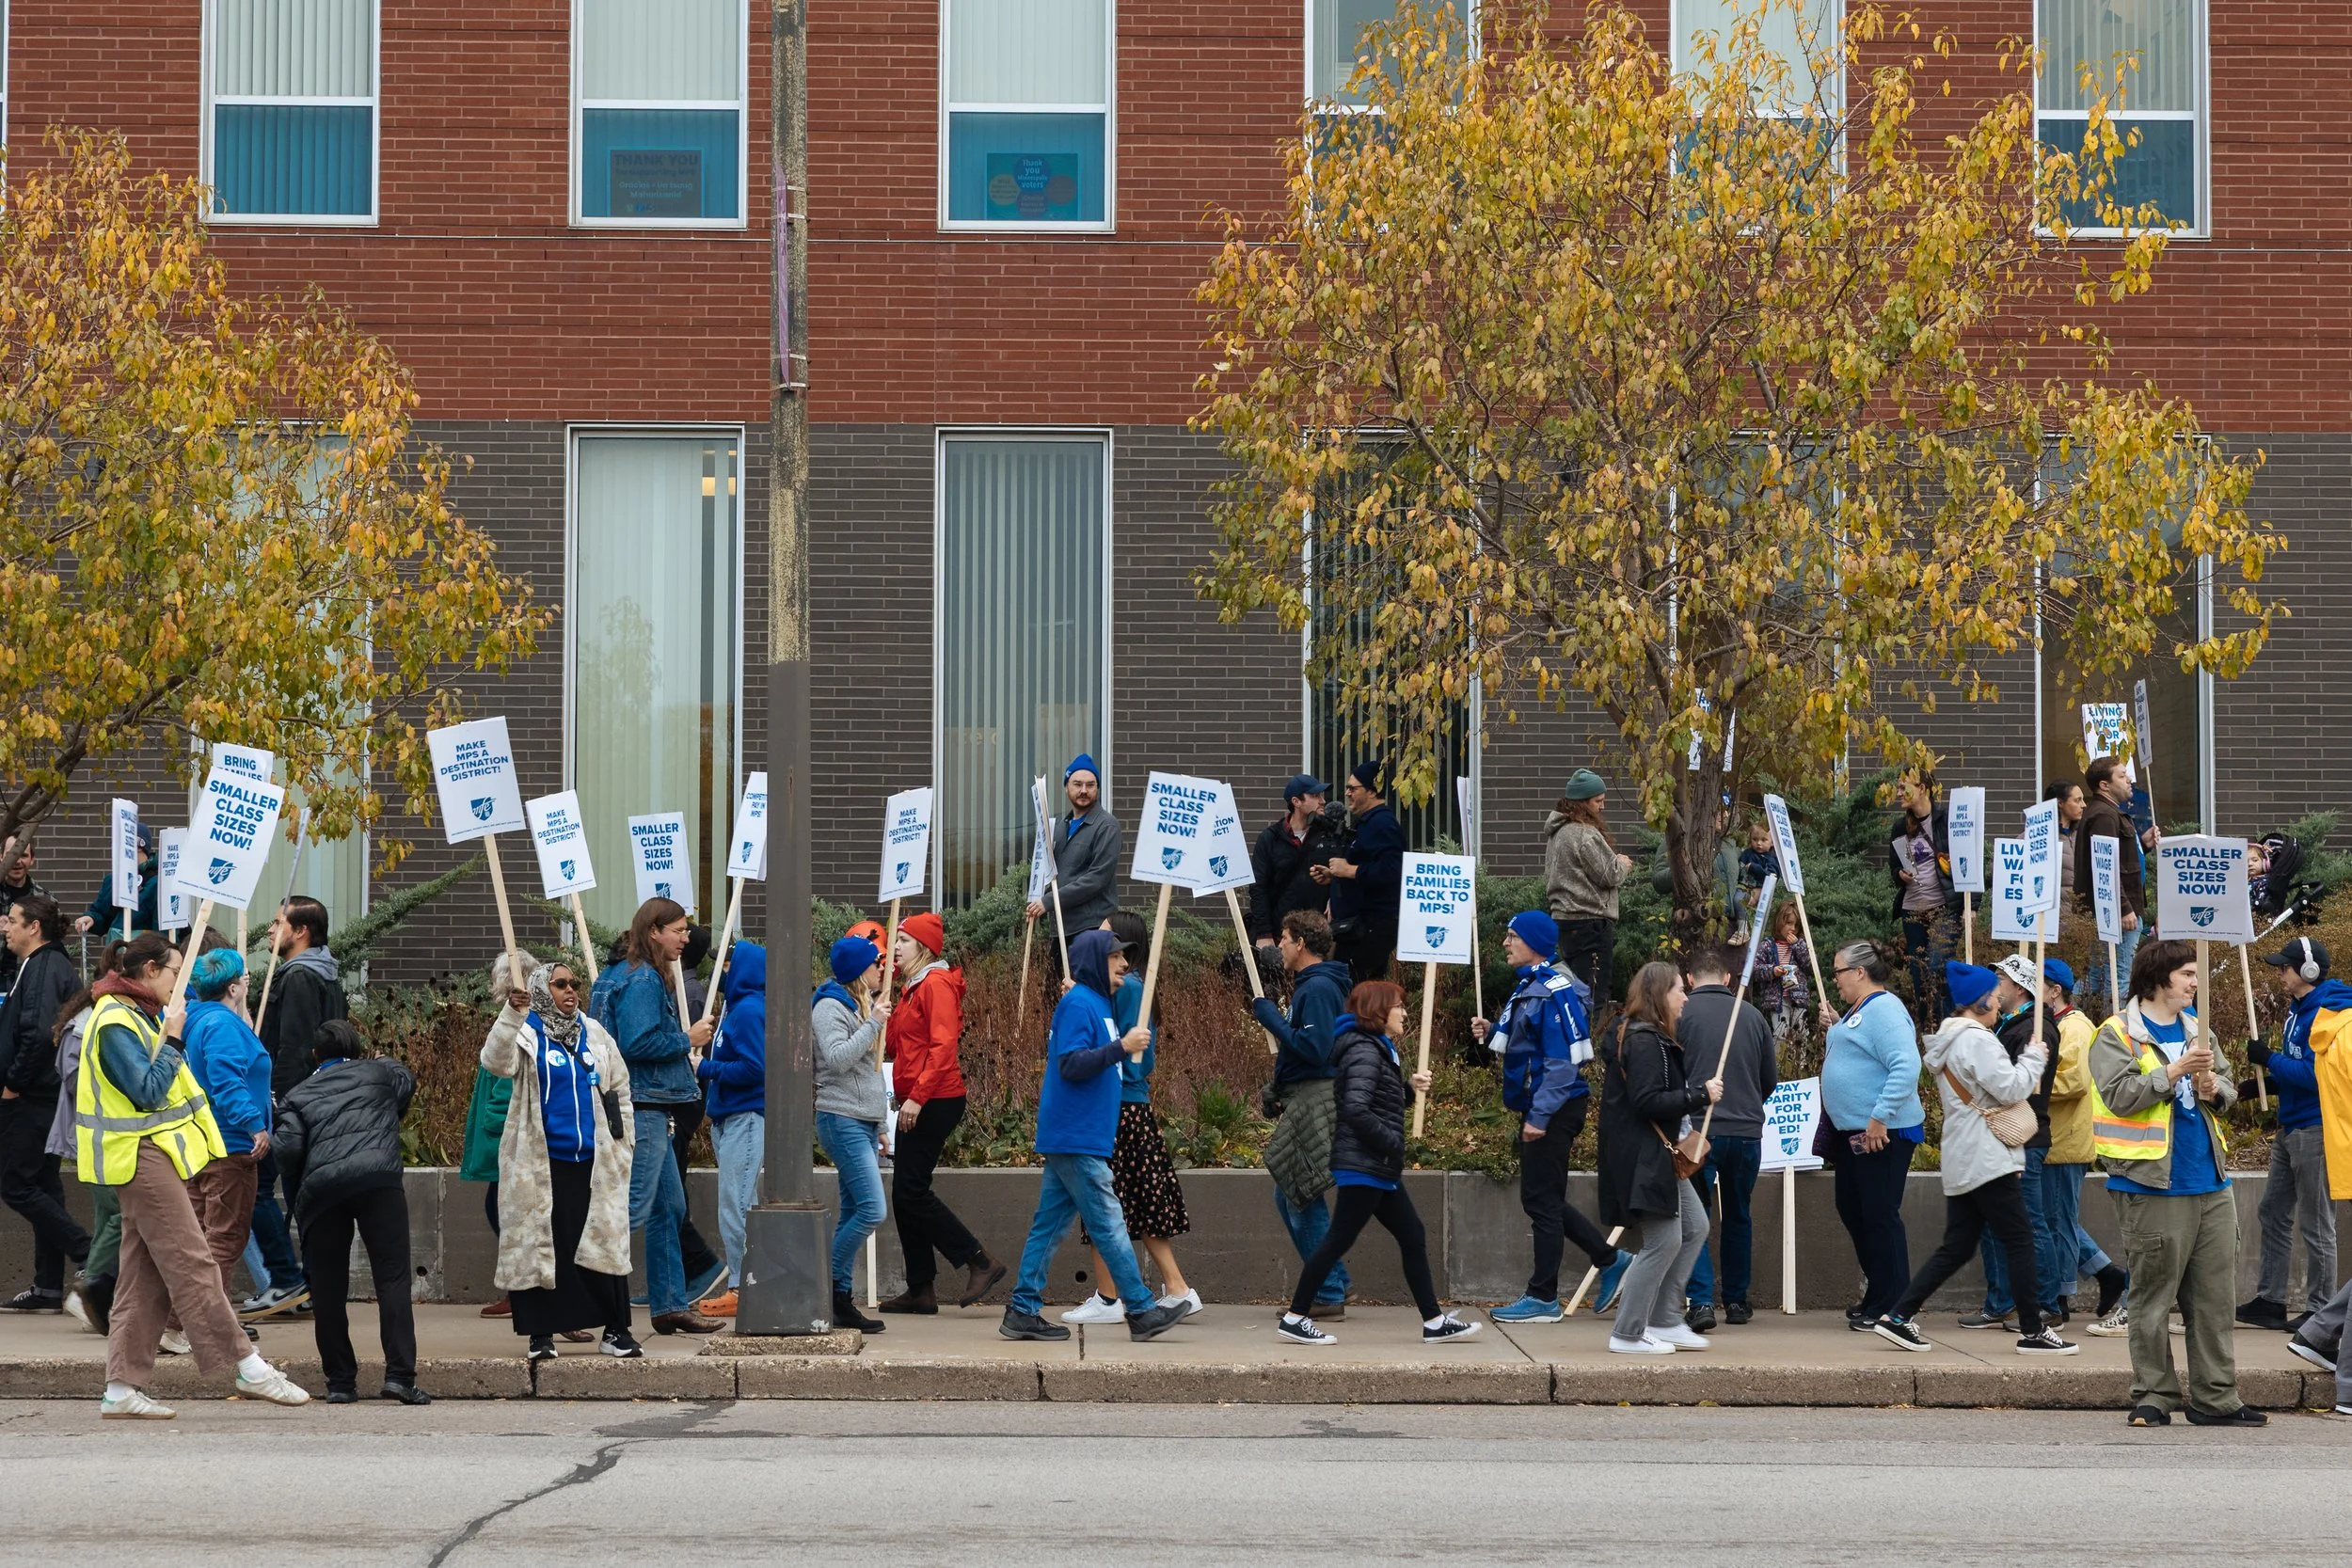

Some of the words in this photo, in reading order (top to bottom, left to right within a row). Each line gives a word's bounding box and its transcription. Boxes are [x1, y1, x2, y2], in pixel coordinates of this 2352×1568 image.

[614, 154, 663, 166] THANK
[668, 154, 698, 166] YOU
[1025, 167, 1041, 176] you
[455, 739, 486, 752] MAKE
[224, 754, 257, 770] BRING
[455, 752, 479, 762] MPS
[440, 755, 509, 775] DESTINATION
[451, 766, 501, 783] DISTRICT!
[209, 780, 278, 812] SMALLER
[1151, 783, 1216, 803] SMALLER
[215, 798, 264, 822] CLASS
[1158, 797, 1204, 814] CLASS
[546, 809, 565, 819] MAKE
[899, 808, 917, 817] MAKE
[1159, 810, 1199, 826] SIZES
[214, 814, 257, 836] SIZES
[547, 818, 563, 828] MPS
[898, 817, 911, 827] MPS
[1214, 816, 1234, 828] TION
[1949, 821, 1974, 830] DESTINATION
[2026, 810, 2053, 829] SMALLER
[537, 822, 580, 839] DESTINATION
[631, 822, 679, 835] SMALLER
[888, 823, 928, 837] DESTINATION
[1157, 822, 1197, 838] NOW!
[1213, 826, 1230, 836] ICT!
[2028, 825, 2048, 839] CLASS
[209, 828, 253, 850] NOW!
[545, 832, 577, 846] DISTRICT!
[640, 835, 673, 847] CLASS
[892, 832, 920, 845] DISTRICT!
[2029, 838, 2047, 852] SIZES
[644, 847, 673, 859] SIZES
[2093, 841, 2112, 856] LIVING
[2161, 847, 2243, 860] SMALLER
[645, 860, 674, 871] NOW!
[1416, 863, 1461, 877] BRING
[2095, 856, 2112, 871] WAGE
[2173, 859, 2231, 871] CLASS
[1406, 876, 1470, 890] FAMILIES
[2098, 873, 2110, 886] FOR
[2178, 871, 2227, 882] SIZES
[1406, 889, 1446, 901] BACK
[1450, 891, 1469, 902] TO
[2178, 883, 2226, 895] NOW!
[1419, 902, 1454, 914] MPS!
[1775, 1083, 1801, 1093] PAY
[1764, 1091, 1812, 1105] PARITY
[1774, 1103, 1802, 1115] FOR
[1767, 1113, 1811, 1126] ADULT
[1778, 1125, 1801, 1134] ED!
